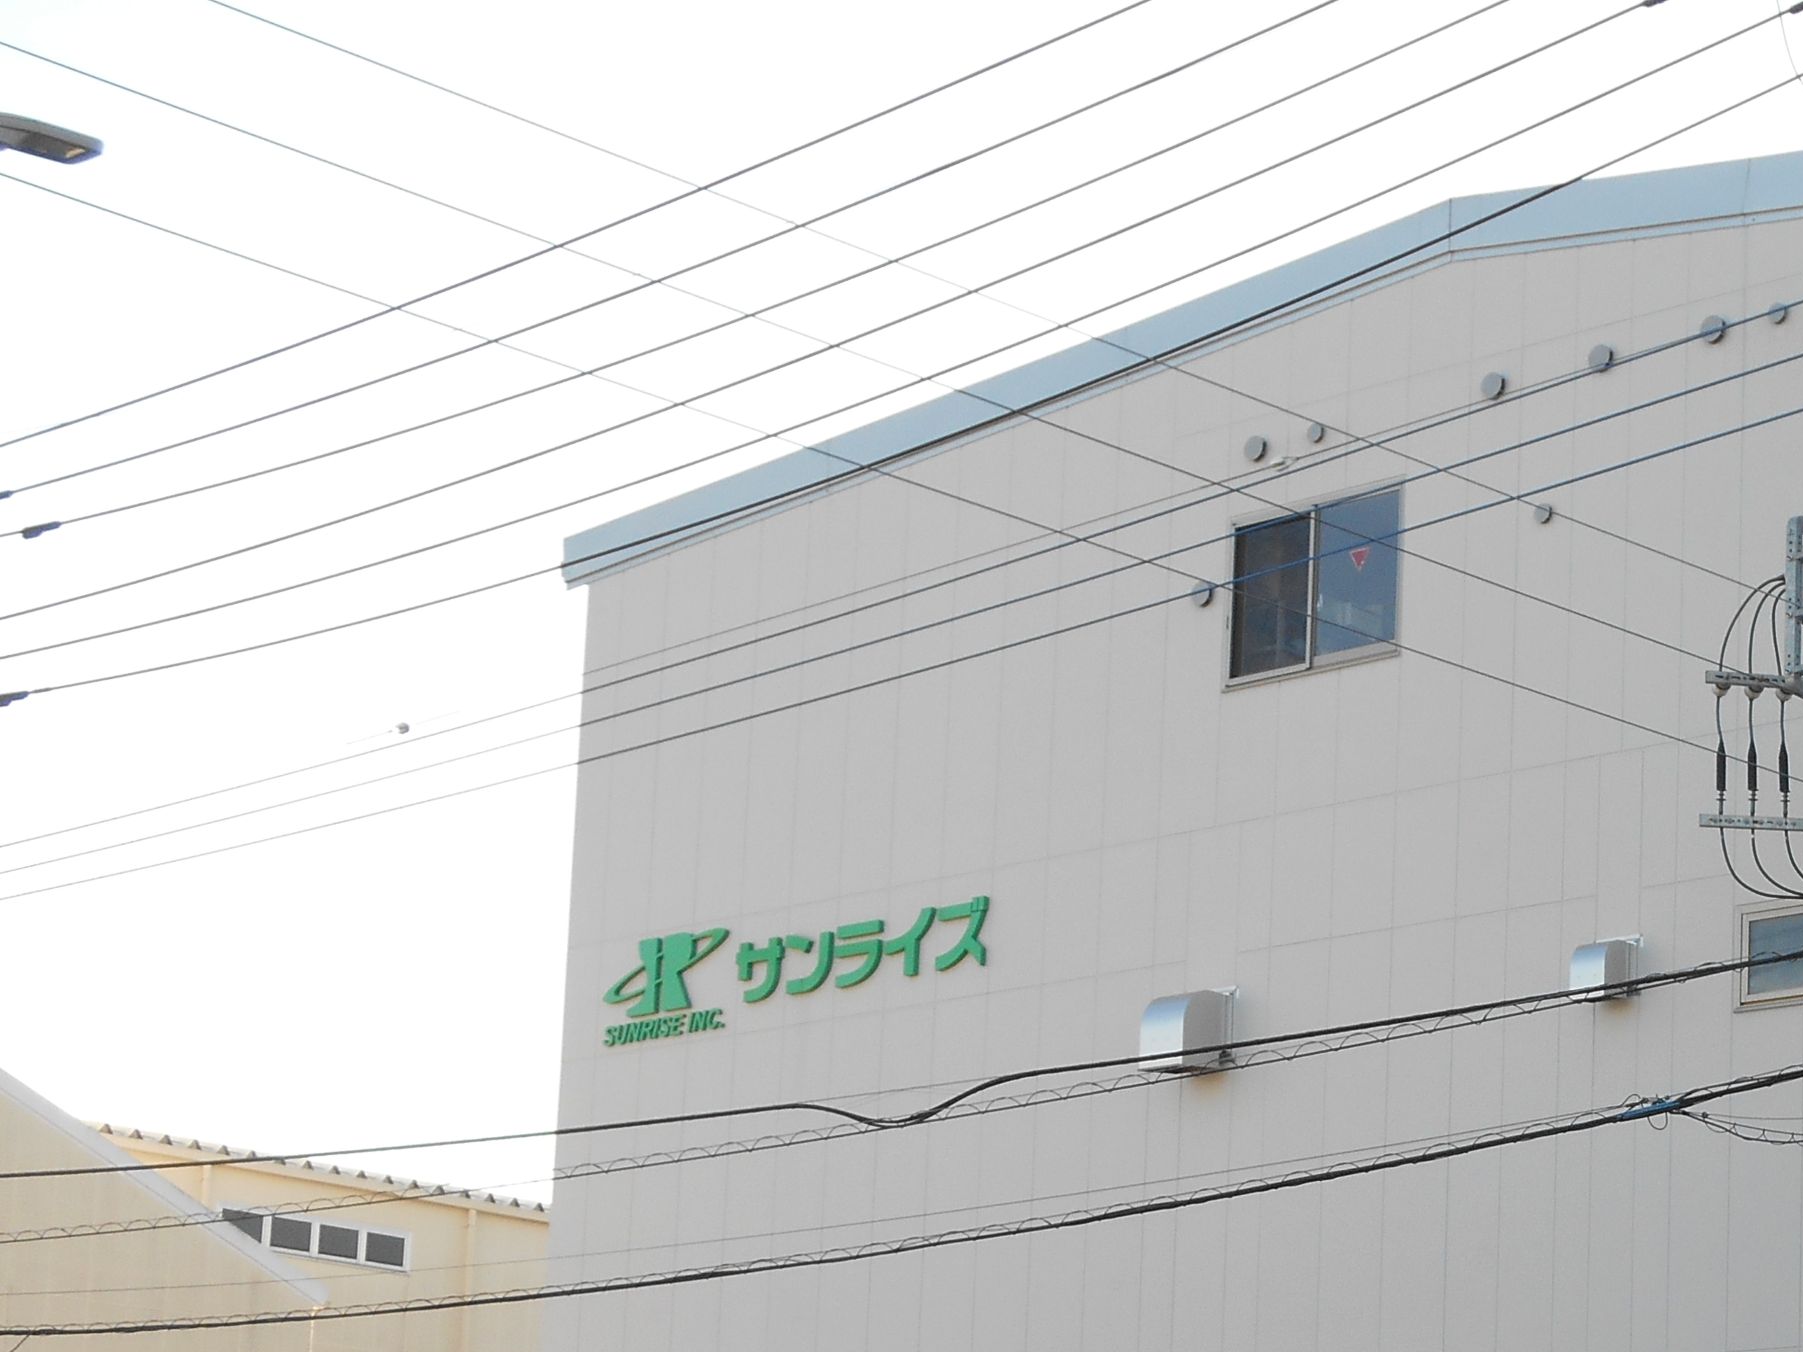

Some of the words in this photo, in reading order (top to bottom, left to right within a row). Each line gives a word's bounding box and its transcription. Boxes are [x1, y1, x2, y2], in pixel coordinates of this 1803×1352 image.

[736, 895, 990, 1003] サンライズ
[604, 1014, 687, 1047] SUNRISE
[688, 1007, 726, 1033] INC.
